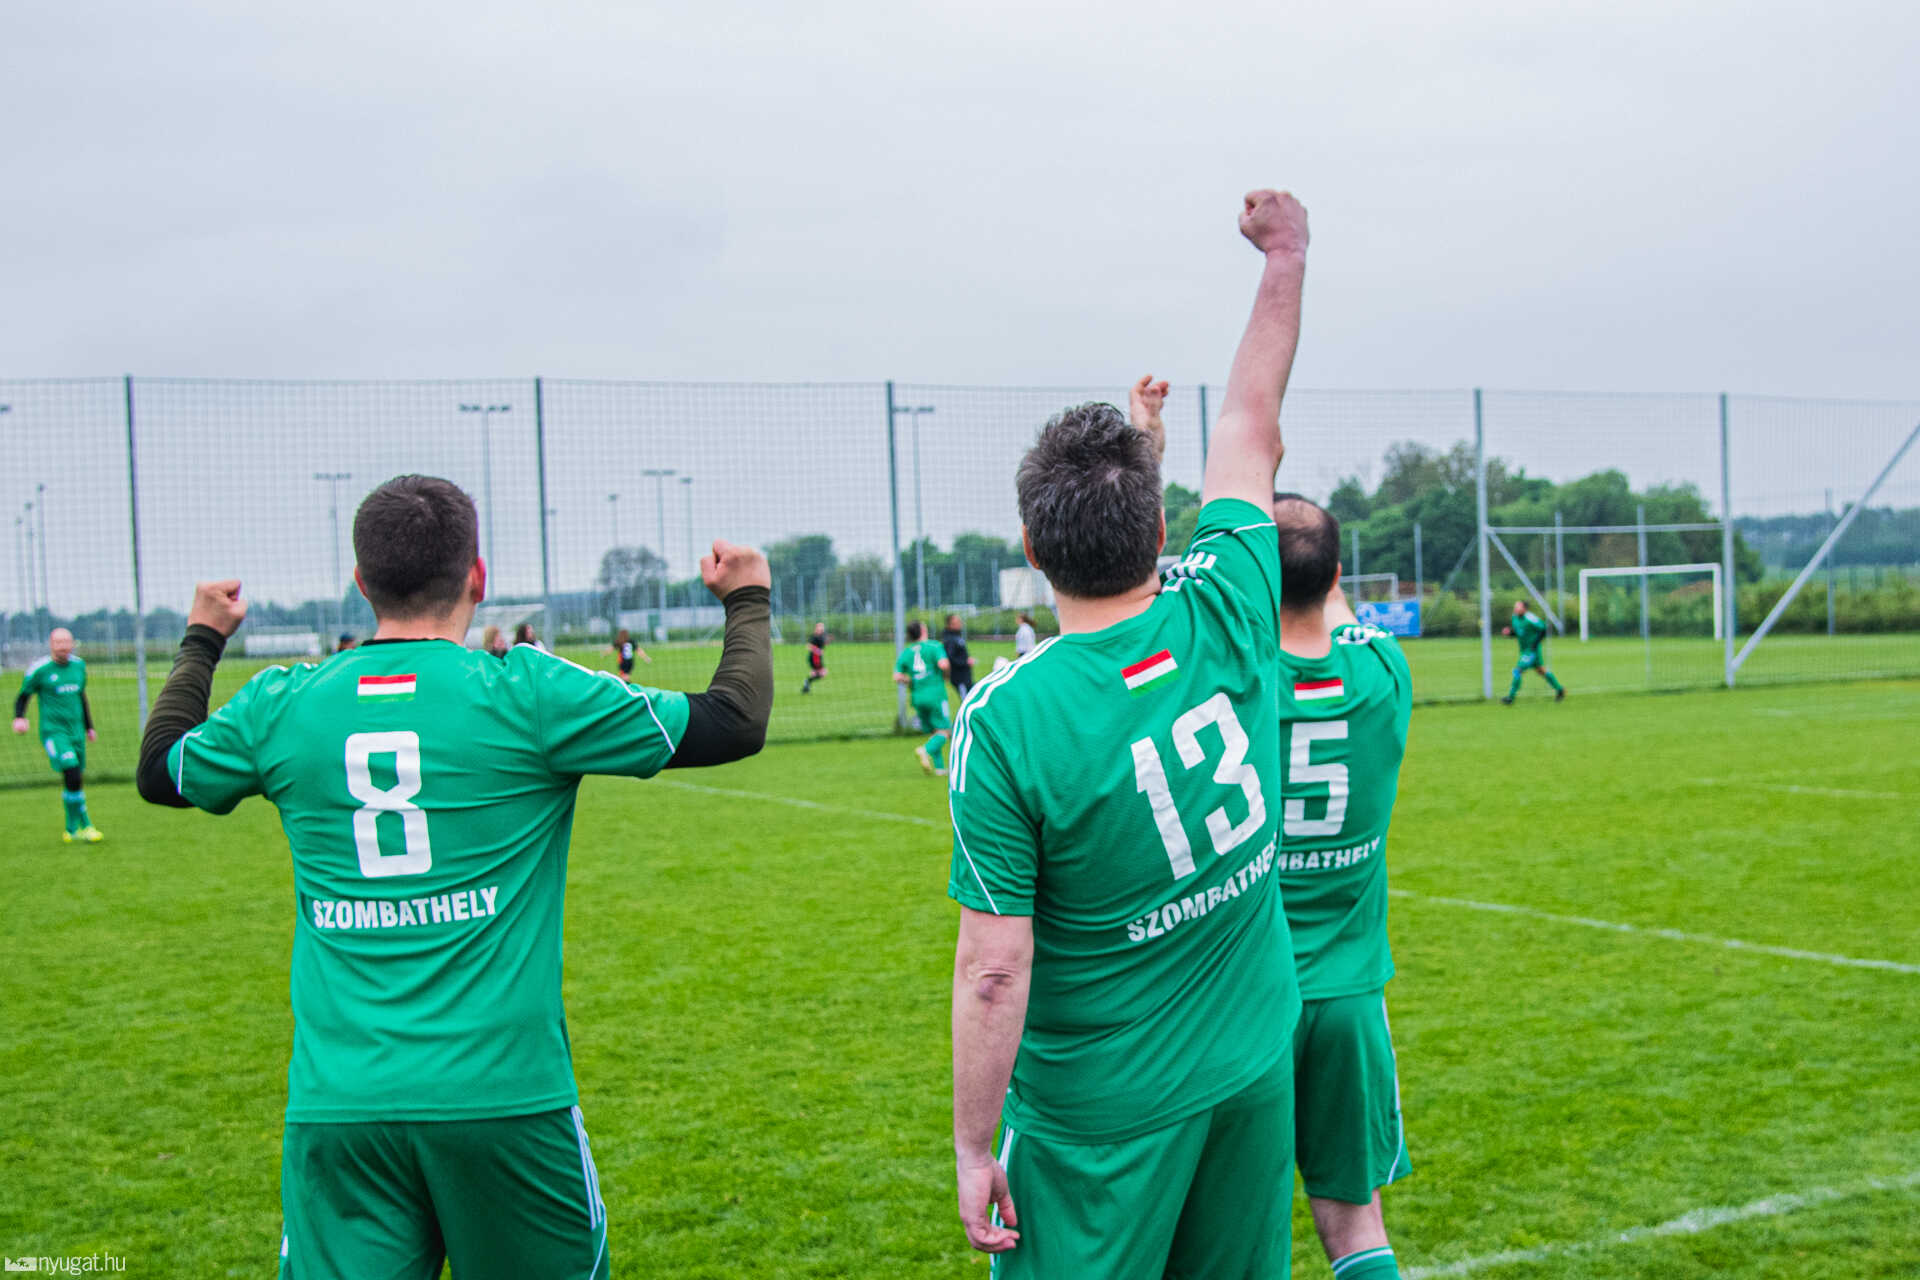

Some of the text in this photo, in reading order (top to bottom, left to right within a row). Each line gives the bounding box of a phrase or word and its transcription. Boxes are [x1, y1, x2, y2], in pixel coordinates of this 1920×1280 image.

[345, 731, 433, 878] 8
[1130, 692, 1267, 881] 13
[1283, 720, 1349, 836] 5
[313, 886, 499, 930] SZOMBATHELY
[1127, 832, 1278, 942] SZOMBATHE
